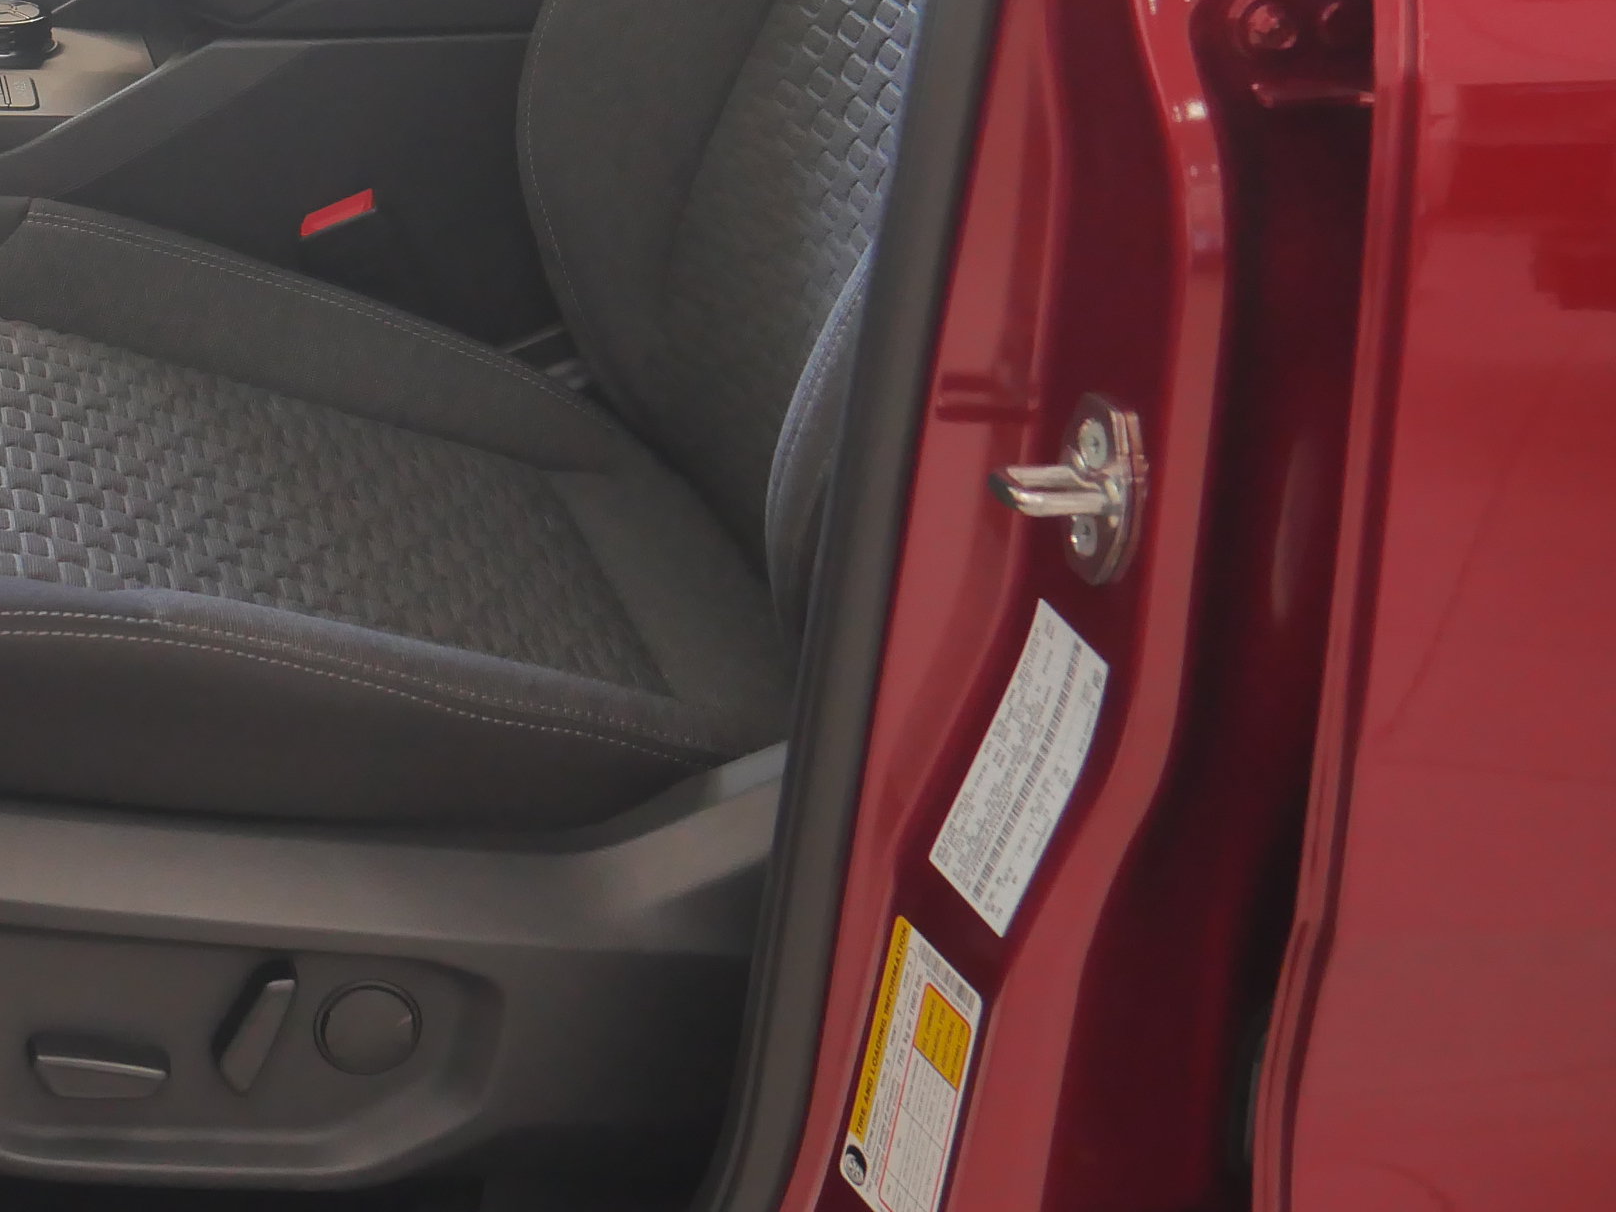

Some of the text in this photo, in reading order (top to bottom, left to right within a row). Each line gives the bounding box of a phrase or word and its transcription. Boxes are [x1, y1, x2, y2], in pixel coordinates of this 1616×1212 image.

[856, 1107, 867, 1135] TIRE
[863, 1078, 874, 1105] AND
[871, 1019, 888, 1076] LOADING
[884, 925, 908, 1016] INFORMATION
